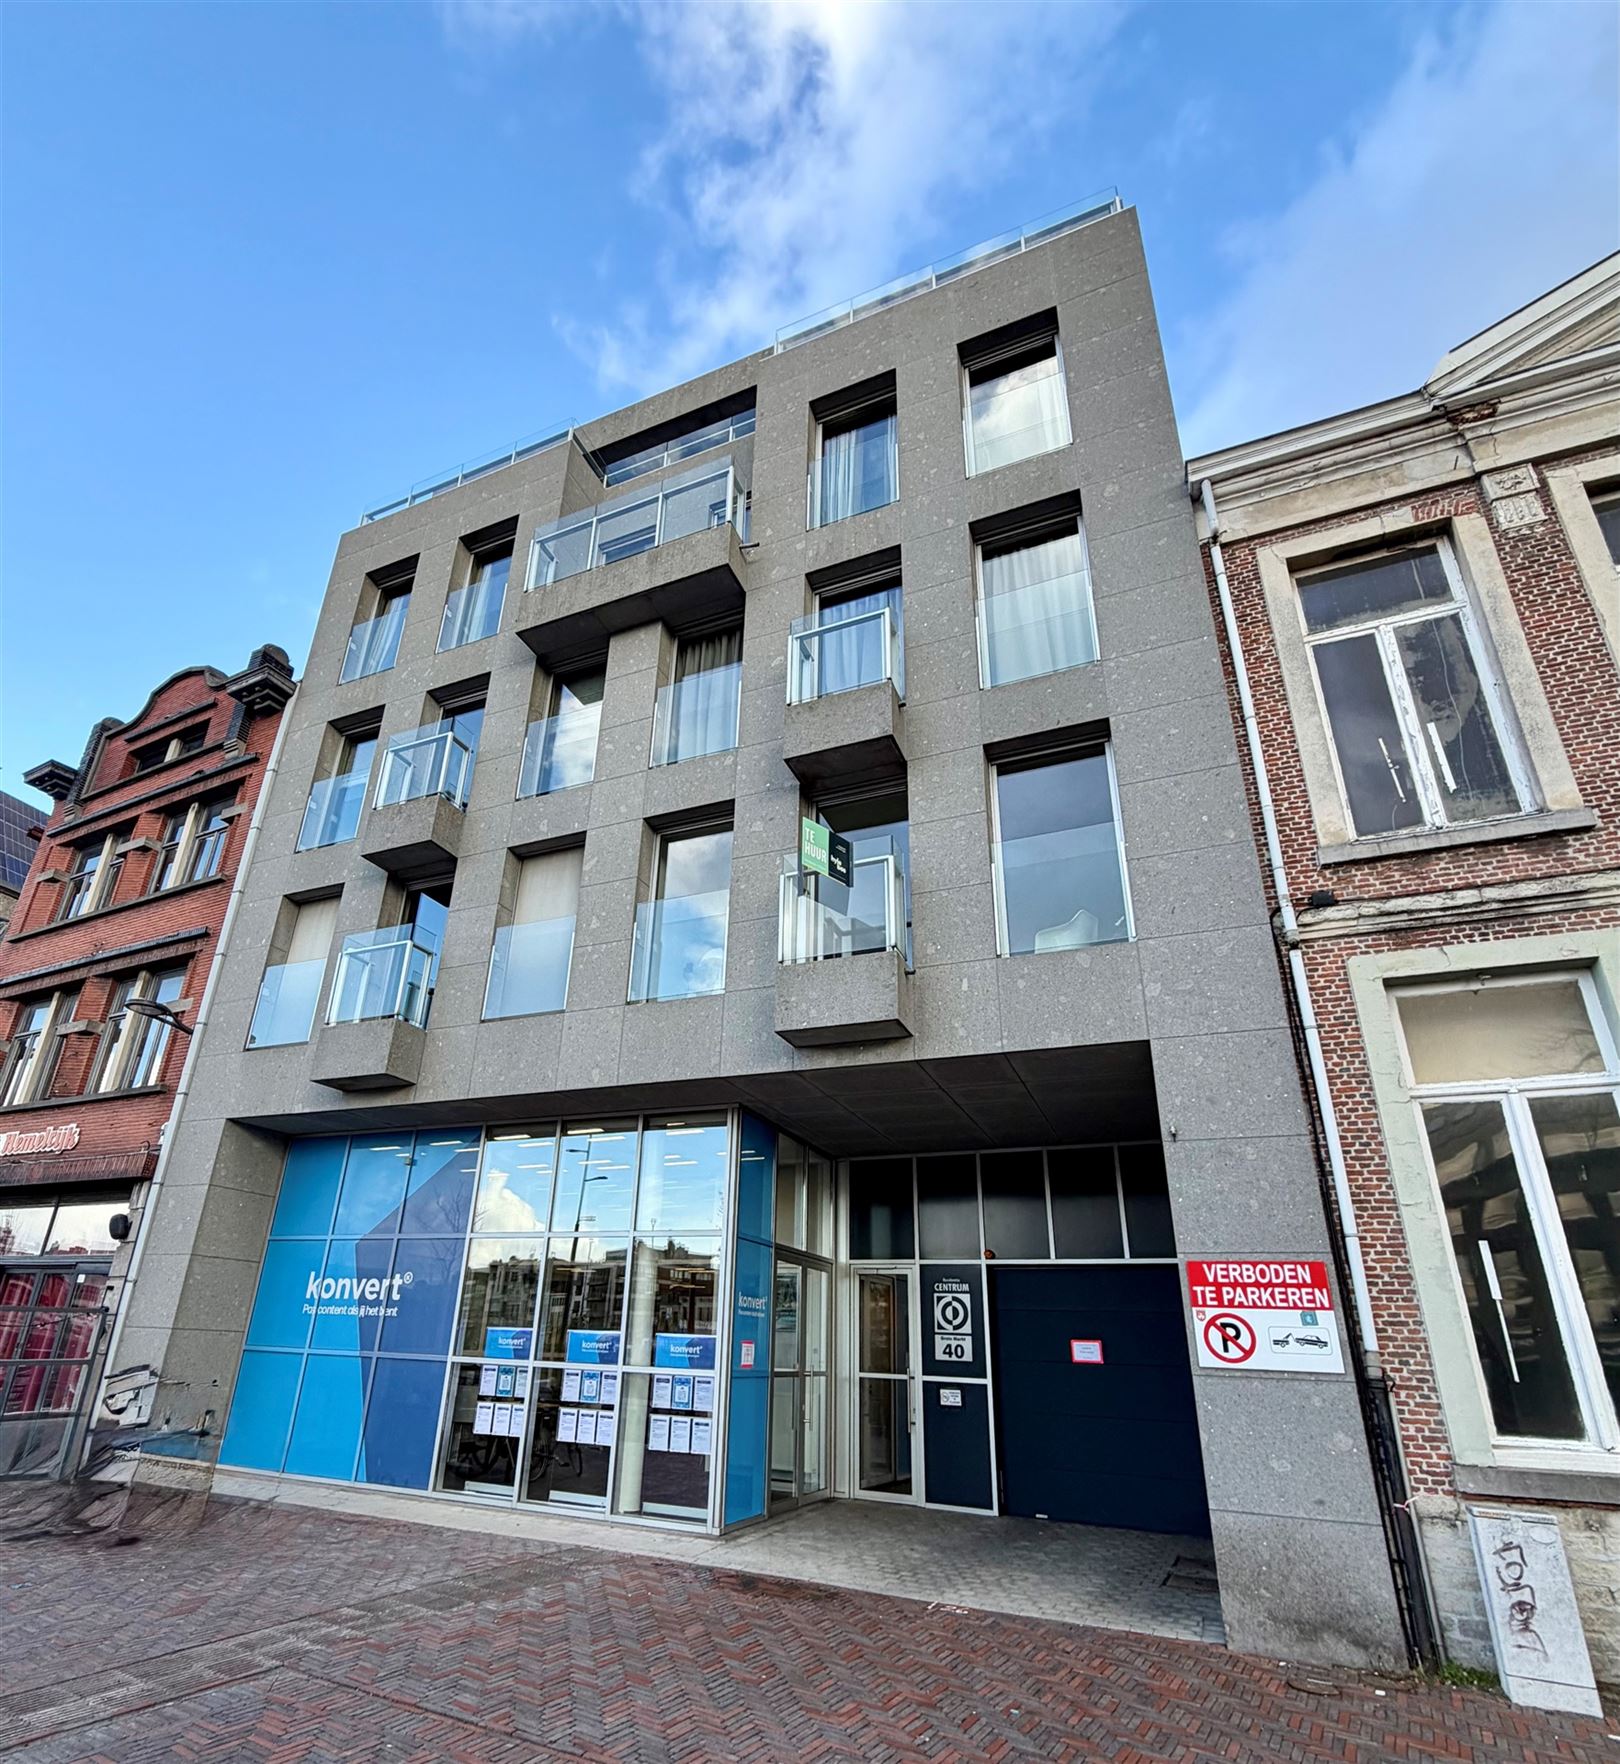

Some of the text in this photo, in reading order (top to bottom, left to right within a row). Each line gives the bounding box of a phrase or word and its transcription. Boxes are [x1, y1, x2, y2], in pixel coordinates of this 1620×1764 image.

[805, 827, 815, 843] TE
[804, 841, 827, 864] HUUR
[1202, 1264, 1312, 1284] VERBODEN
[934, 1283, 970, 1291] CENTRUM
[1193, 1286, 1330, 1308] TE PARKEREN
[318, 1304, 347, 1315] content
[365, 1306, 378, 1316] het
[942, 1343, 965, 1359] 40
